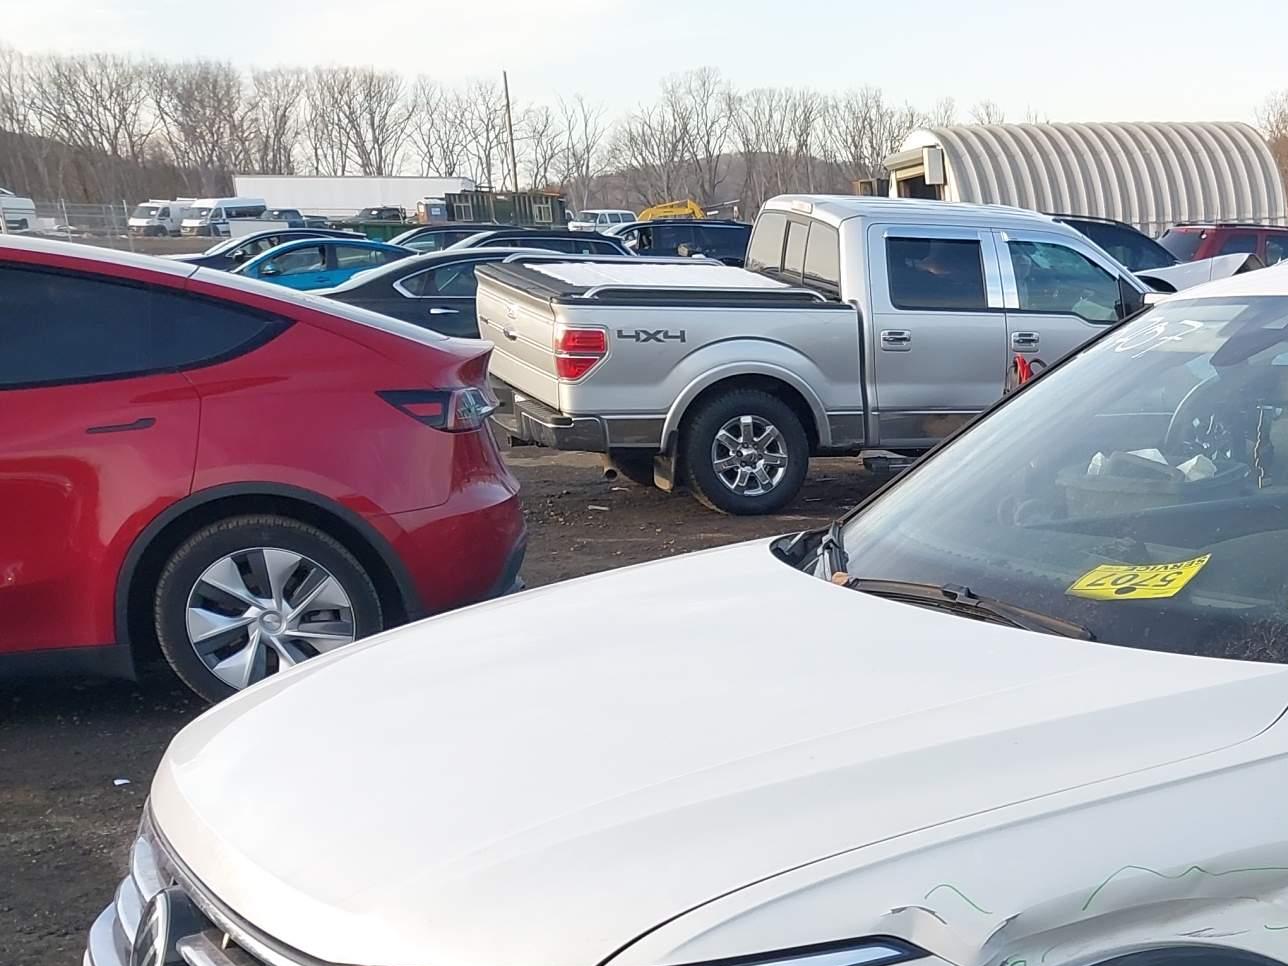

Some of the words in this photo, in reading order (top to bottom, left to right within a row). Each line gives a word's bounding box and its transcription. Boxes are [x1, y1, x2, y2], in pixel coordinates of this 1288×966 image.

[616, 329, 687, 343] 4X4
[1126, 558, 1206, 572] SERVICE
[1085, 571, 1183, 588] 5707
